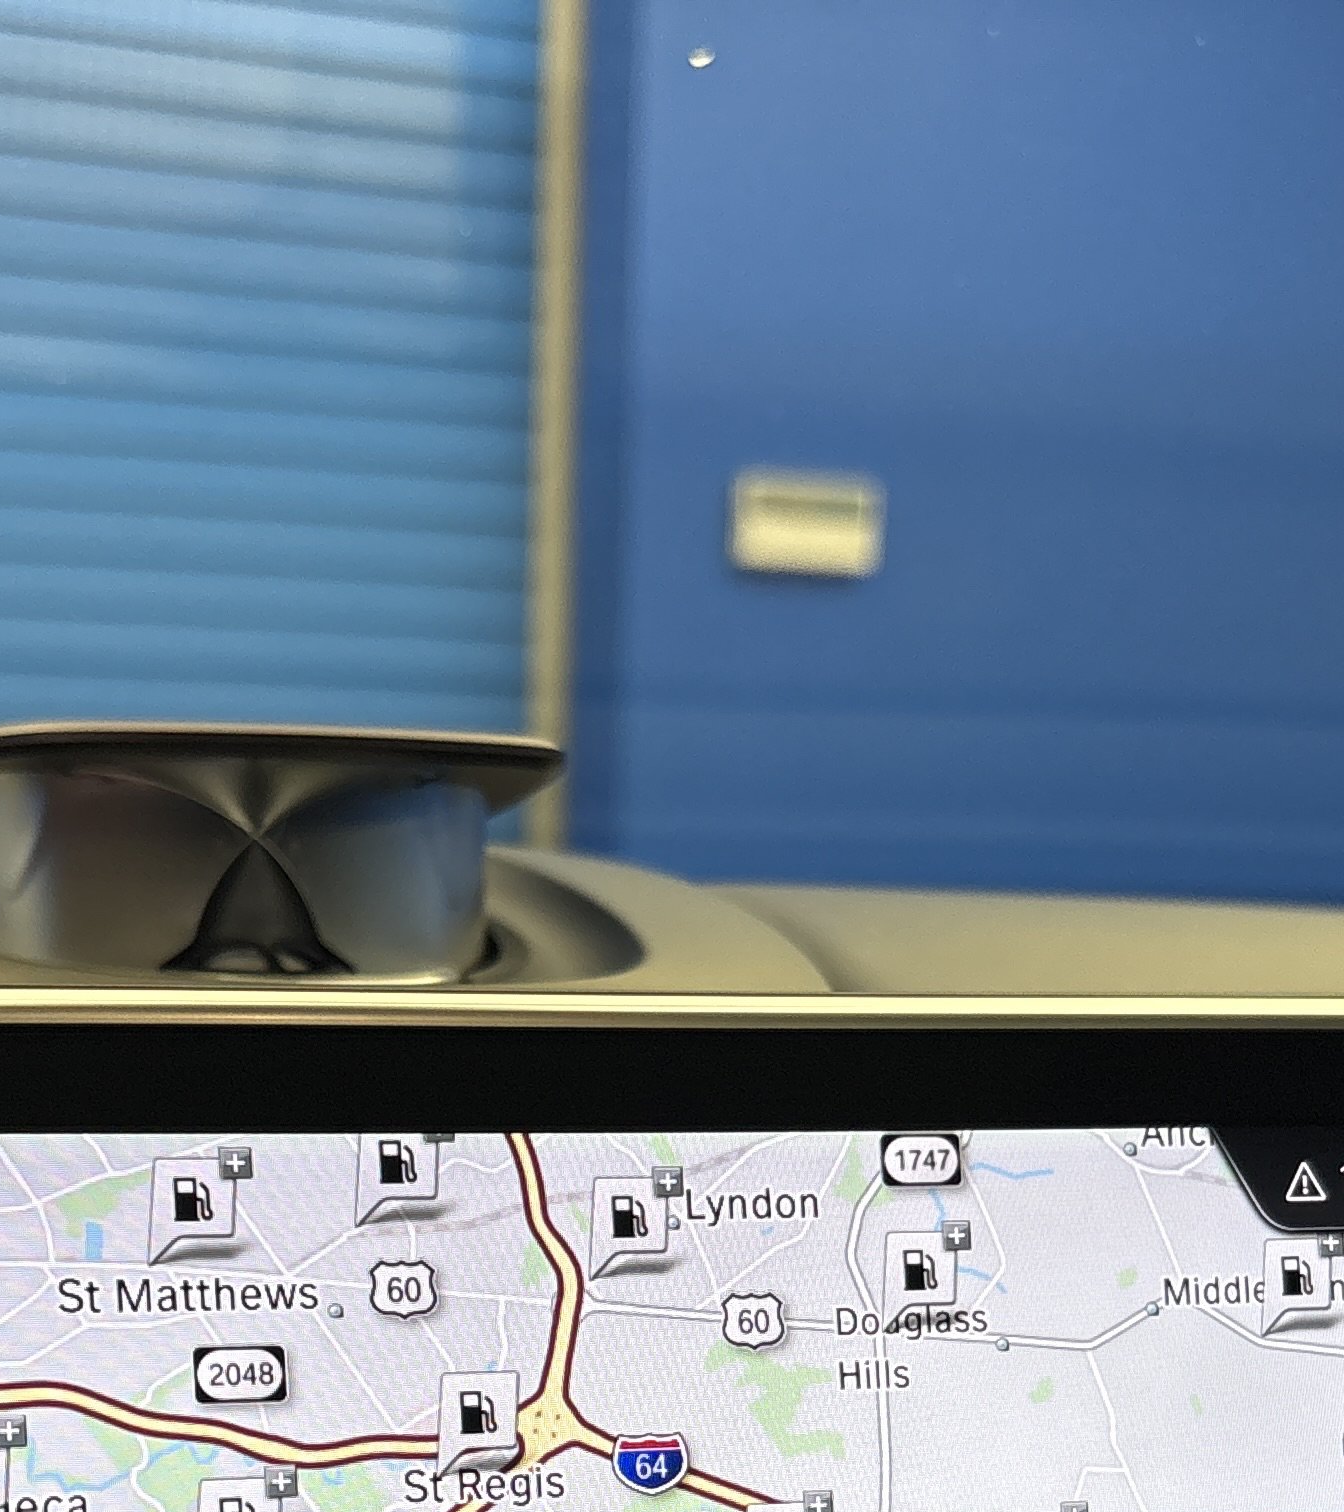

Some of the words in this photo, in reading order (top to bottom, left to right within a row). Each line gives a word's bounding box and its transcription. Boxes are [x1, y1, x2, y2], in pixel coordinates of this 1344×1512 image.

[895, 1148, 951, 1172] 1747
[686, 1189, 820, 1223] Lyndon
[58, 1279, 102, 1314] St
[117, 1278, 319, 1314] Matthews
[387, 1274, 422, 1303] 60
[739, 1309, 771, 1334] 60
[209, 1361, 275, 1387] 2048
[839, 1360, 911, 1390] Hills
[635, 1454, 668, 1479] 64
[405, 1469, 444, 1503] St
[458, 1467, 565, 1506] Regis
